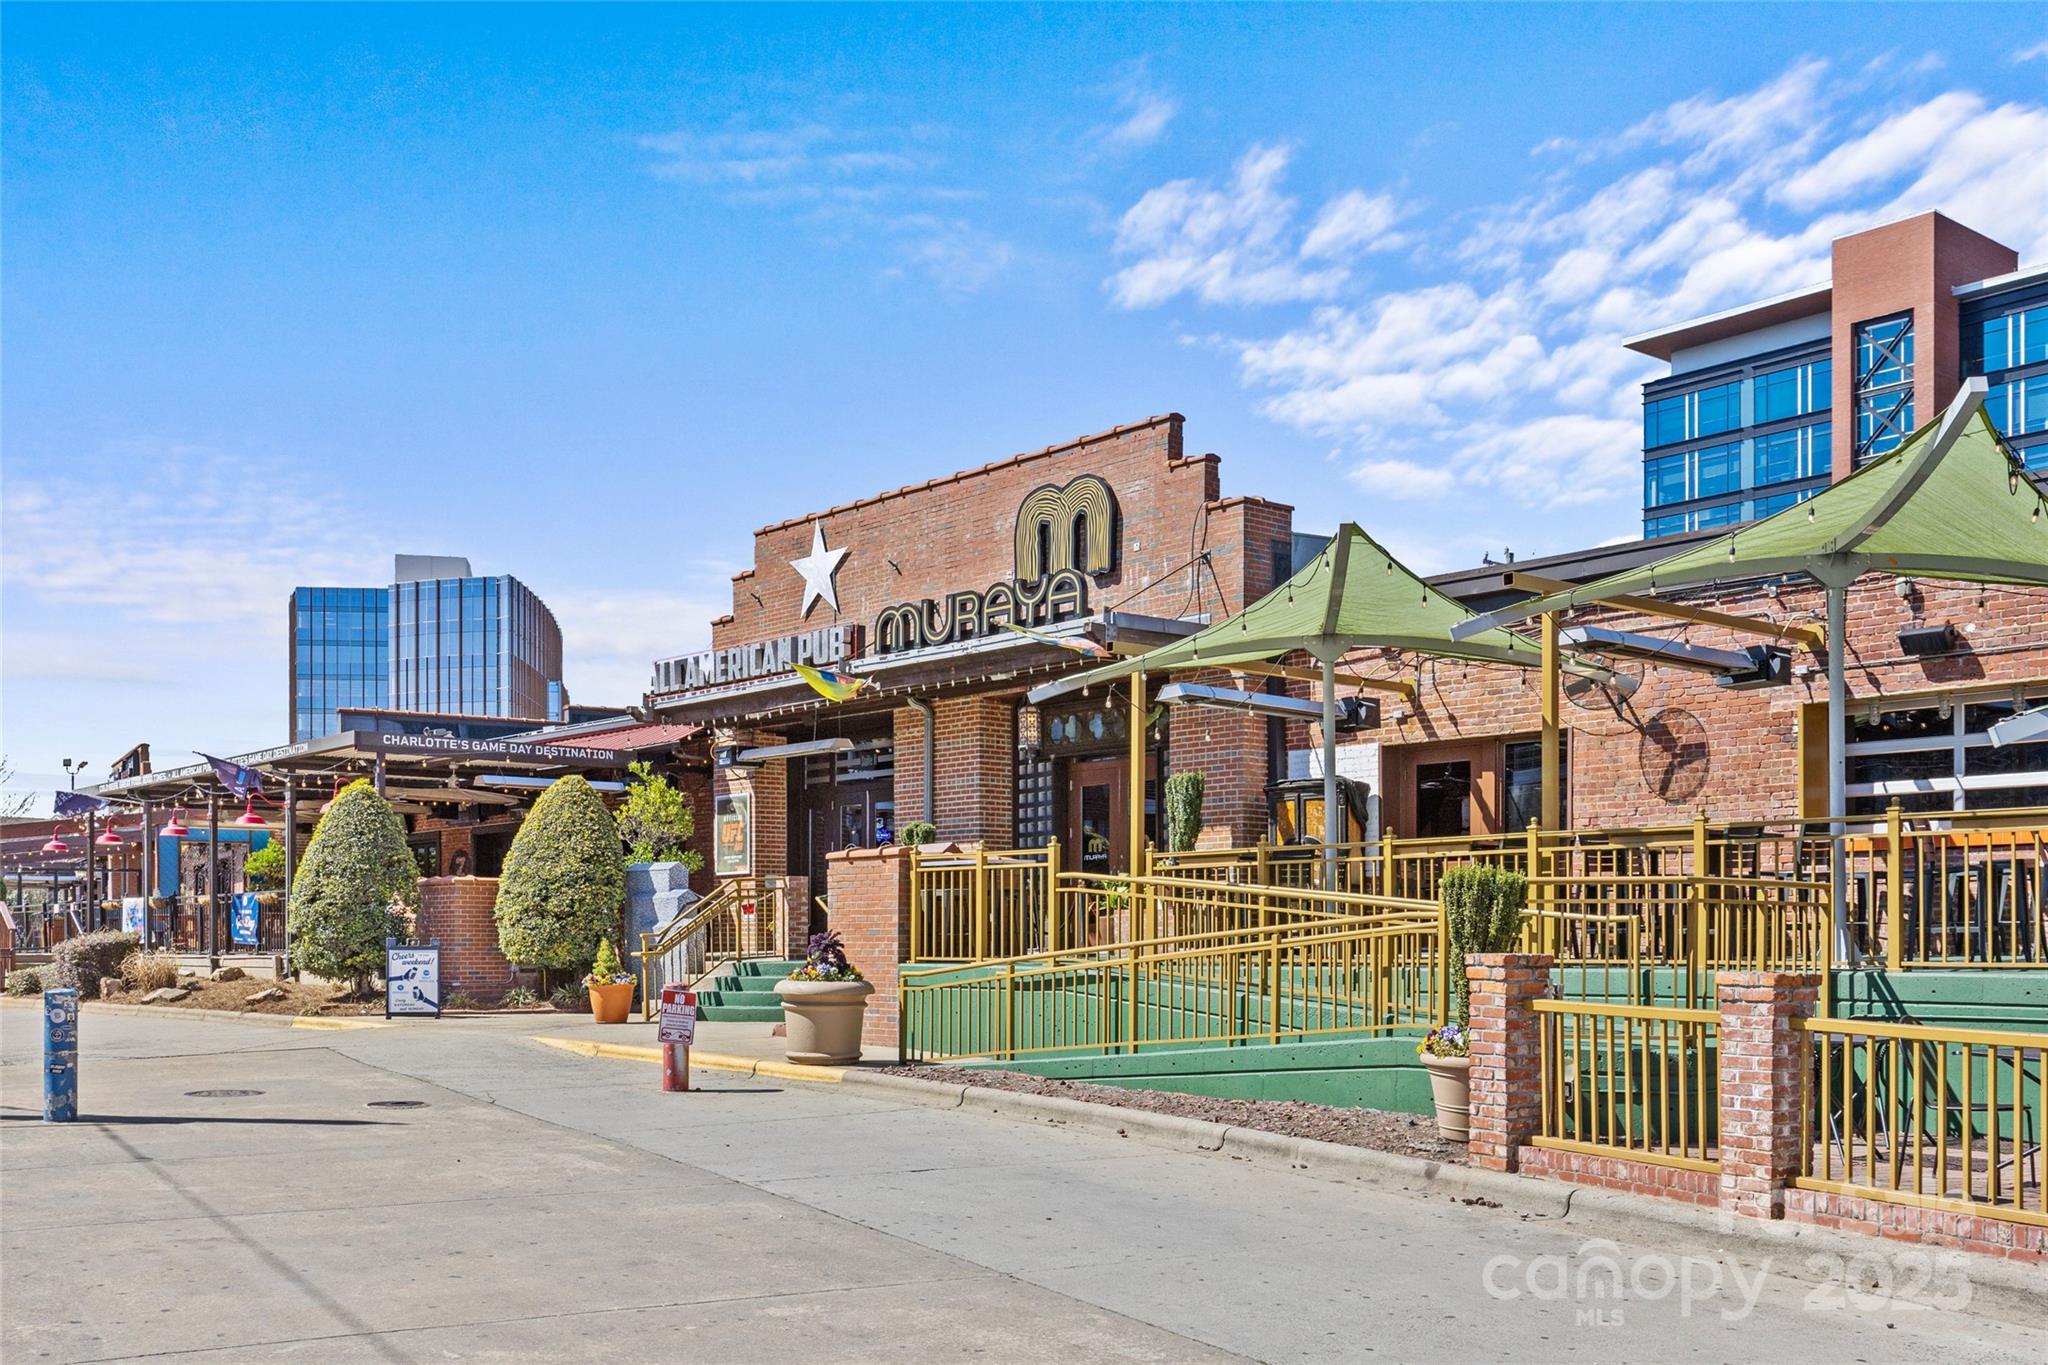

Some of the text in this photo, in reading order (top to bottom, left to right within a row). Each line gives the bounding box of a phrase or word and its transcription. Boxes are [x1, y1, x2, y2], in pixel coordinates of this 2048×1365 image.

[875, 568, 1089, 654] MURAYA
[684, 636, 793, 689] AMERICAN
[798, 625, 846, 665] PUB
[382, 734, 615, 760] CHARLOTTE'S GAME DAY DESTINATION
[662, 1003, 695, 1016] PARKING
[674, 993, 686, 1004] NO
